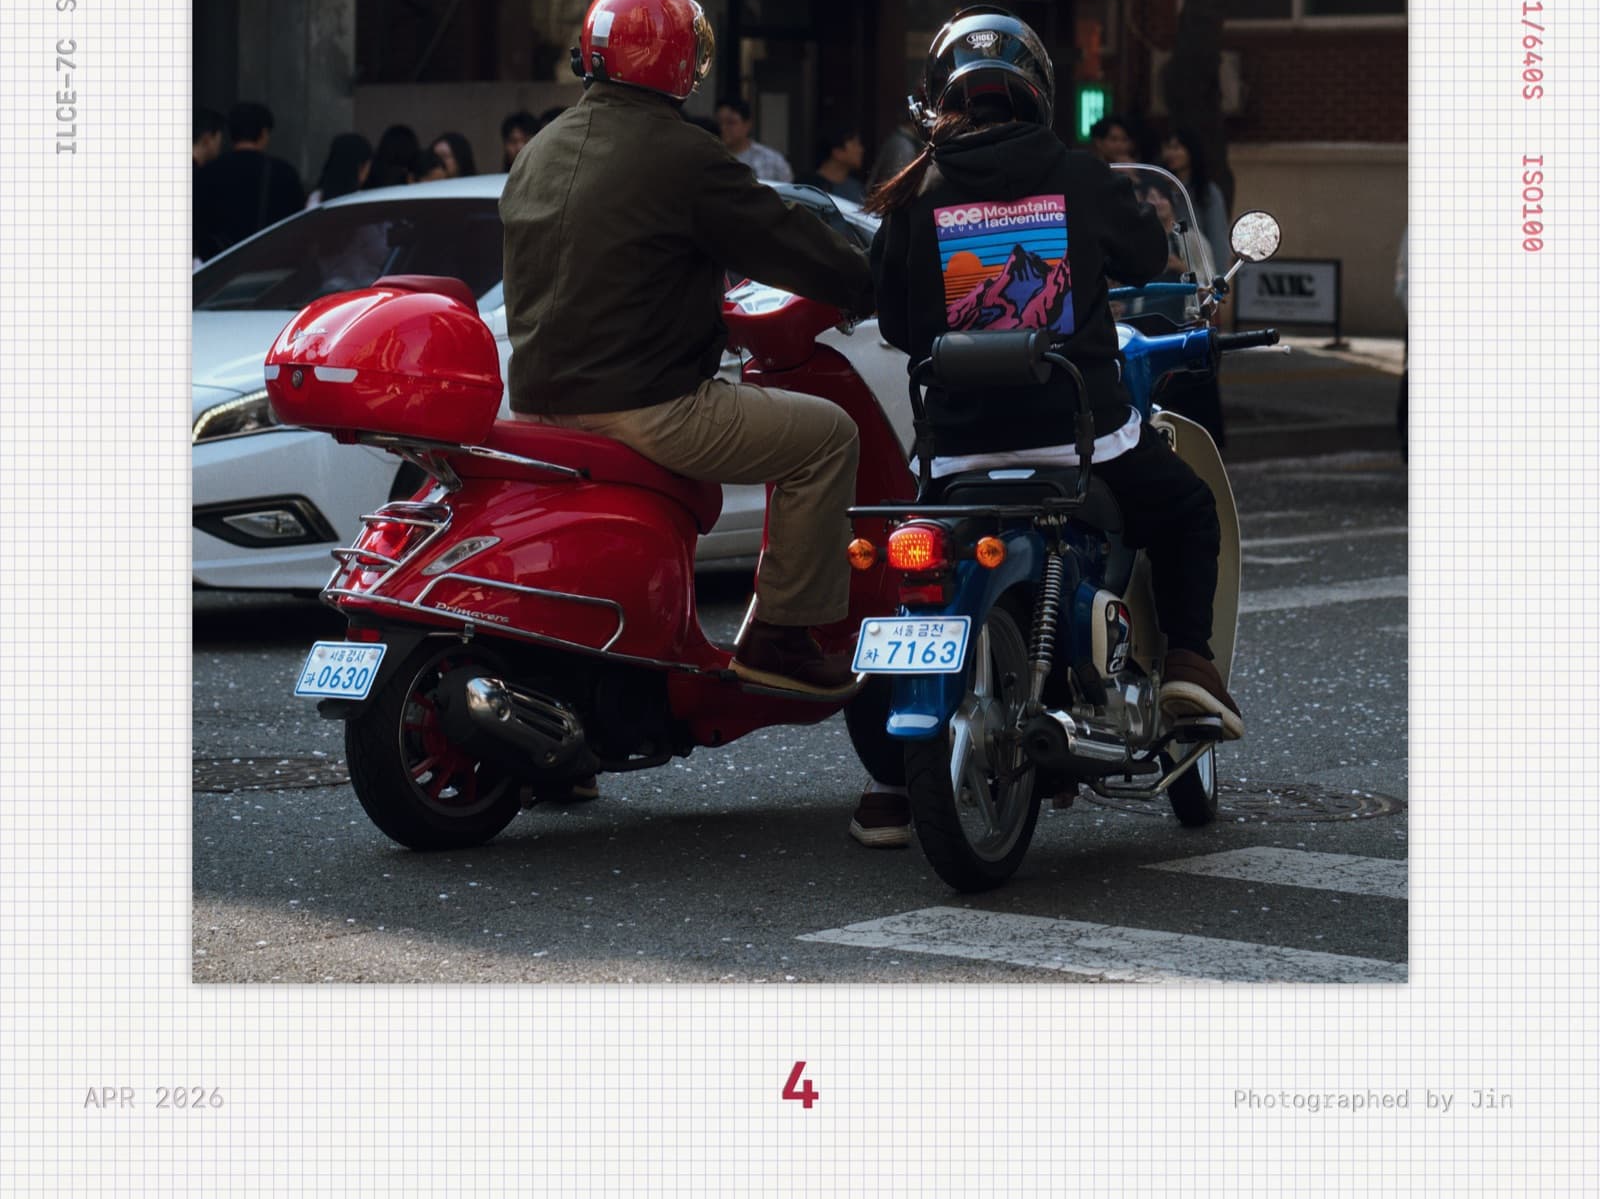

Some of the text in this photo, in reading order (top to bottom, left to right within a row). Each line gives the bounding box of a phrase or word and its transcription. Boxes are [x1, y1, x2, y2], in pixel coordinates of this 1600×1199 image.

[984, 199, 1057, 217] Mountain
[989, 211, 1065, 229] adventure
[434, 601, 511, 624] Primavera
[886, 640, 957, 665] 7163
[317, 665, 370, 691] 0630
